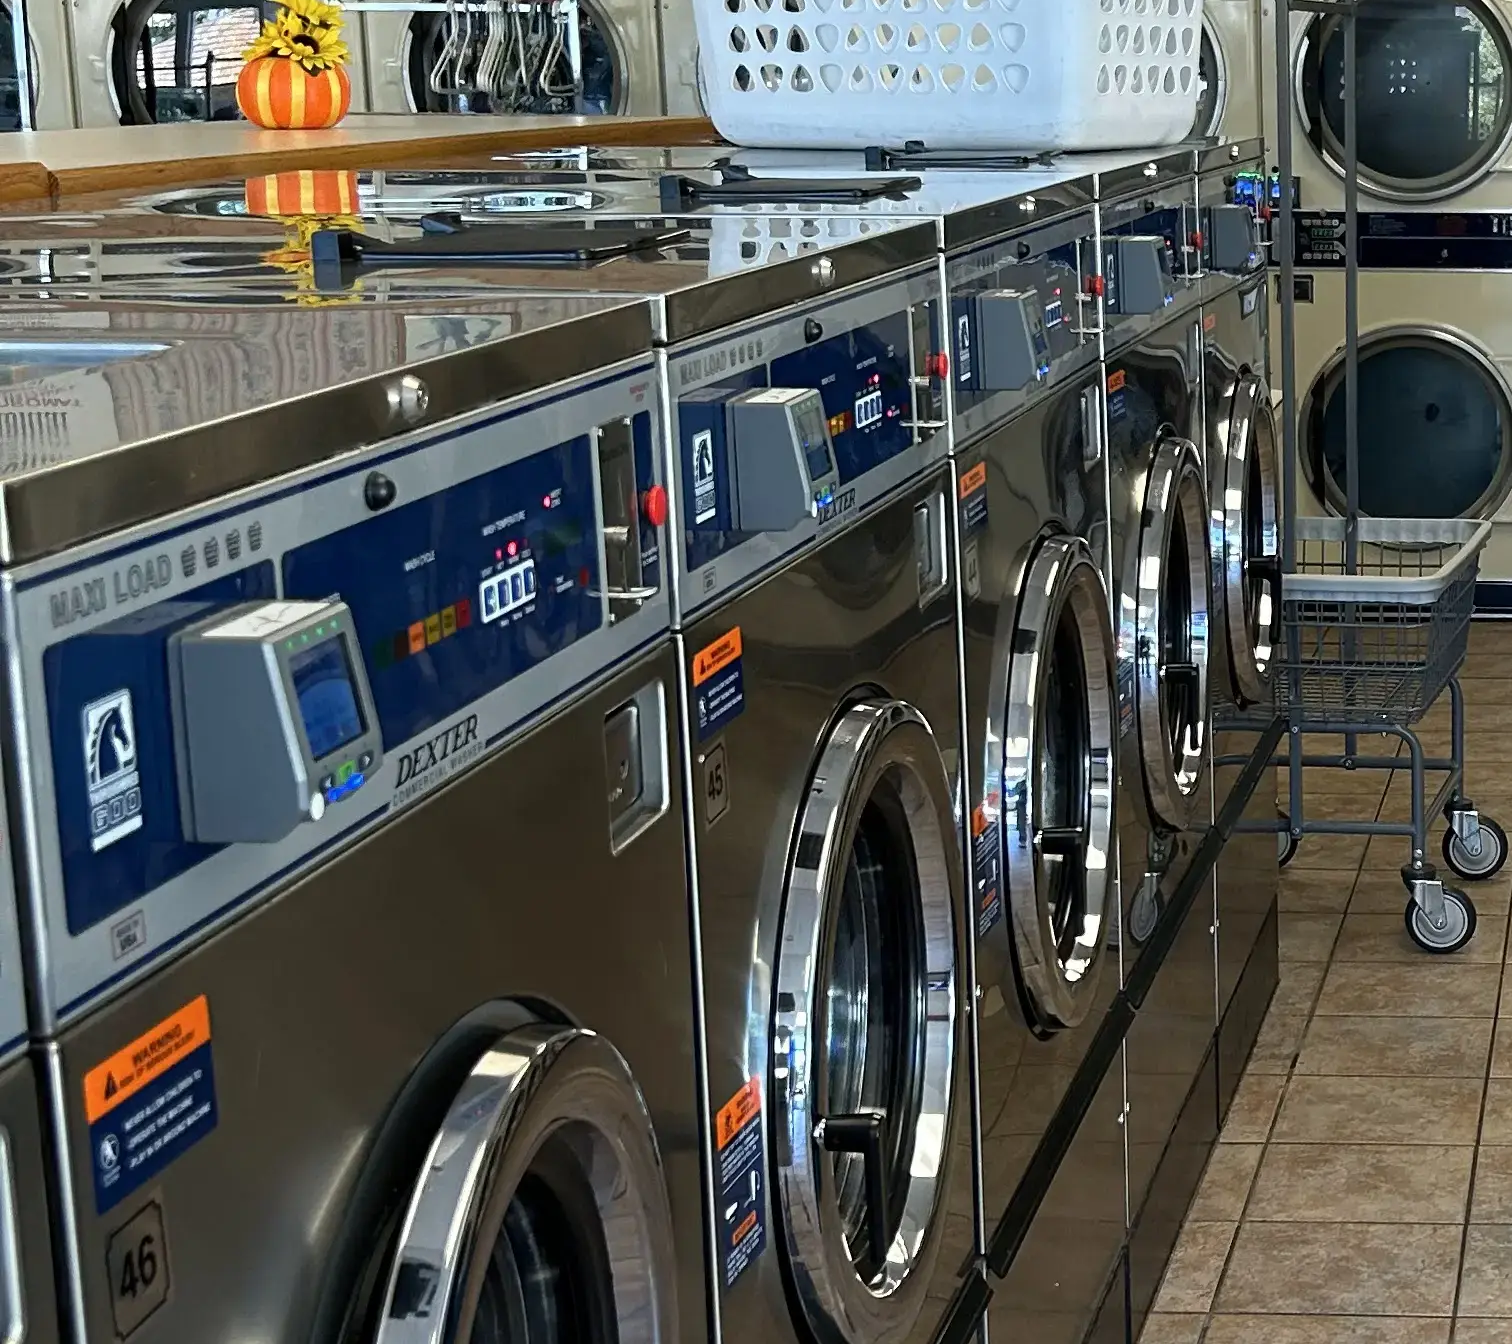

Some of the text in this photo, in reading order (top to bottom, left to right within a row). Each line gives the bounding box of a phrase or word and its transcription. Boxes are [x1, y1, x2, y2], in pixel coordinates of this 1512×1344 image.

[50, 553, 172, 629] MAXI LOAD
[395, 713, 478, 790] DEXTER
[708, 763, 724, 800] 45
[120, 1234, 158, 1298] 46
